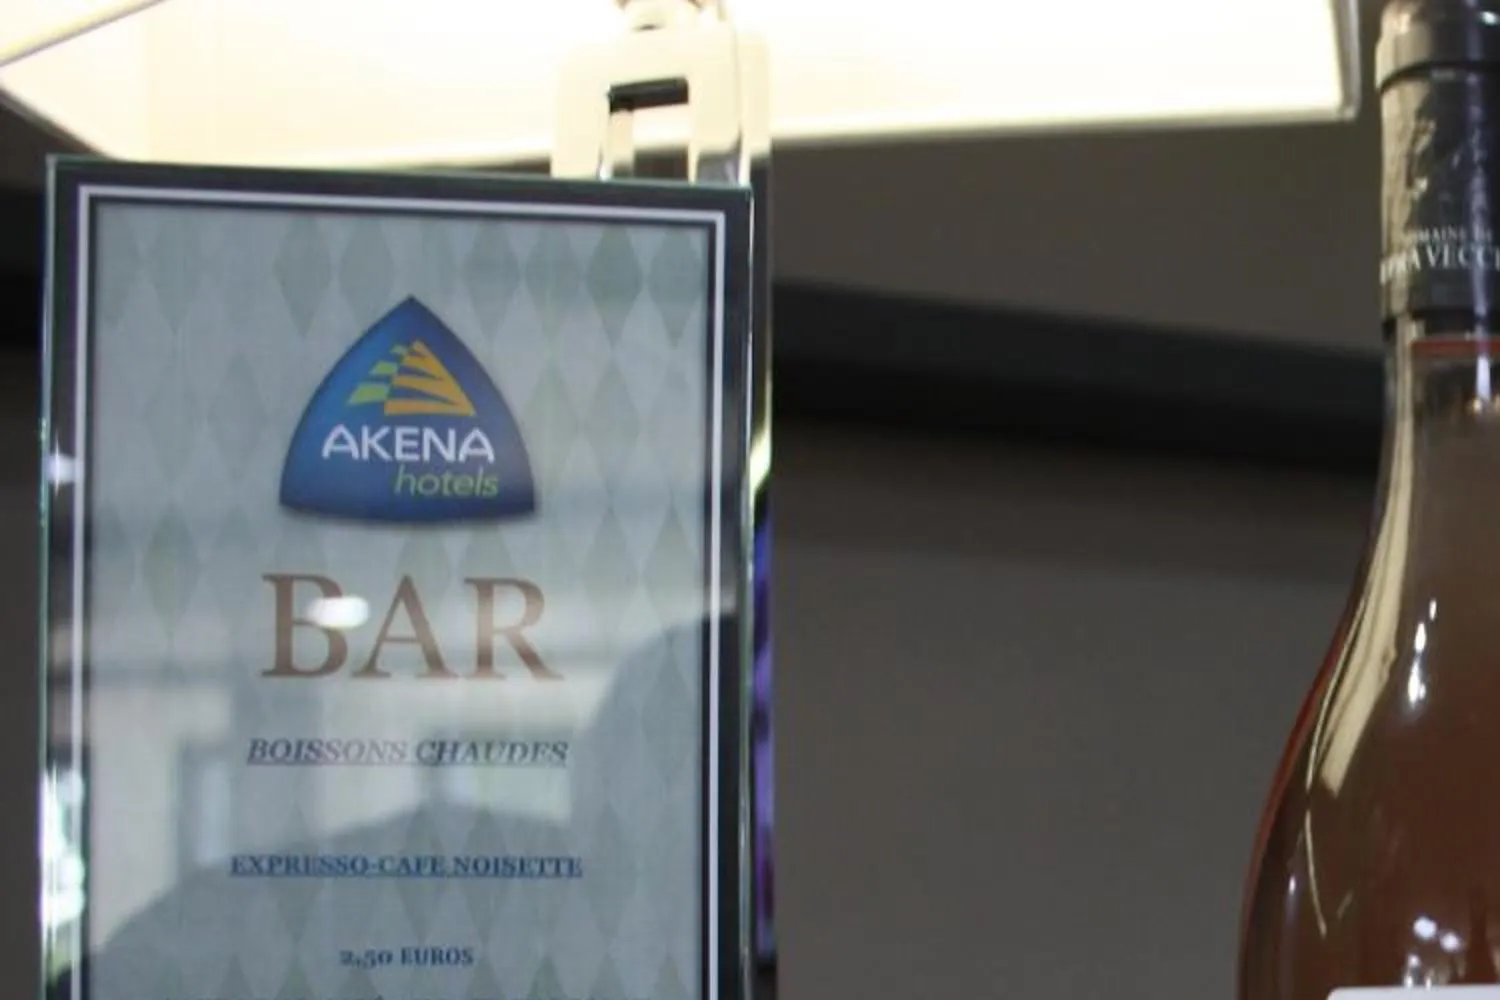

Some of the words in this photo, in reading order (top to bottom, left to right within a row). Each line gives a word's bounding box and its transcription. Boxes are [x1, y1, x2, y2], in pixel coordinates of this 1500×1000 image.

[321, 423, 496, 465] AKENA
[393, 464, 500, 498] hotels
[259, 571, 566, 682] BAR
[248, 737, 409, 764] BOISSONS
[415, 740, 570, 766] CHAUDES
[452, 855, 583, 879] NOISETTE
[400, 946, 475, 967] EUROS
